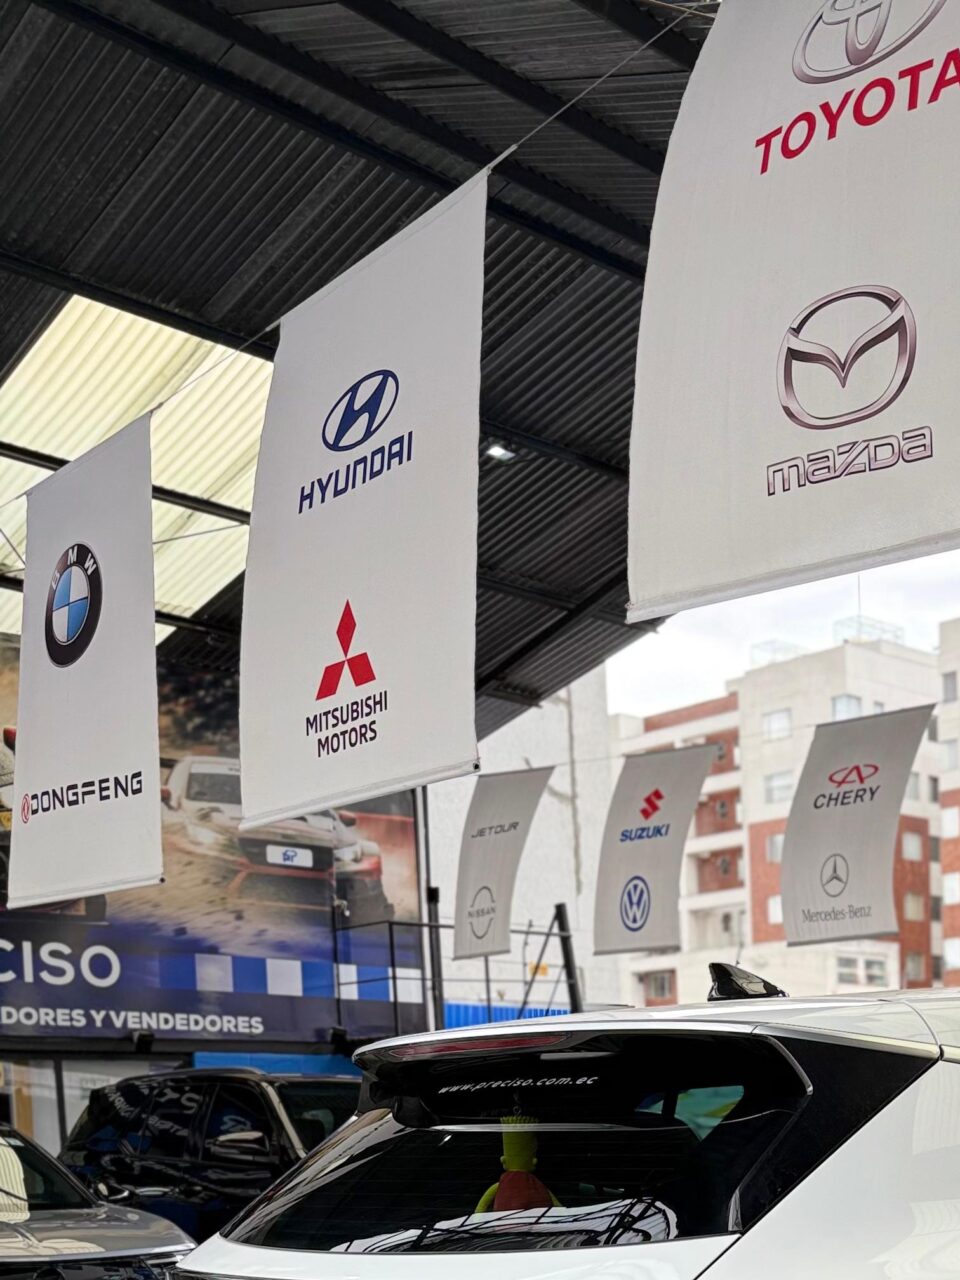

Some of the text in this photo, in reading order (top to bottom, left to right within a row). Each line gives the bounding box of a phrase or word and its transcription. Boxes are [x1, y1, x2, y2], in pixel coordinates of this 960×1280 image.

[298, 431, 414, 514] HYUNDAI
[51, 545, 97, 590] BMW
[305, 690, 389, 737] MITSUBISHI
[317, 720, 378, 758] MOTORS
[30, 771, 144, 816] DONGFENG
[813, 786, 881, 810] CHERY
[470, 821, 520, 839] JETOUR
[619, 823, 671, 843] SUZUKI
[467, 906, 497, 919] NISSAN
[801, 904, 873, 924] Mercedes-Benz
[1, 1006, 264, 1034] DORES Y VENDEDORES
[438, 1075, 599, 1095] www.preciso.com.ec
